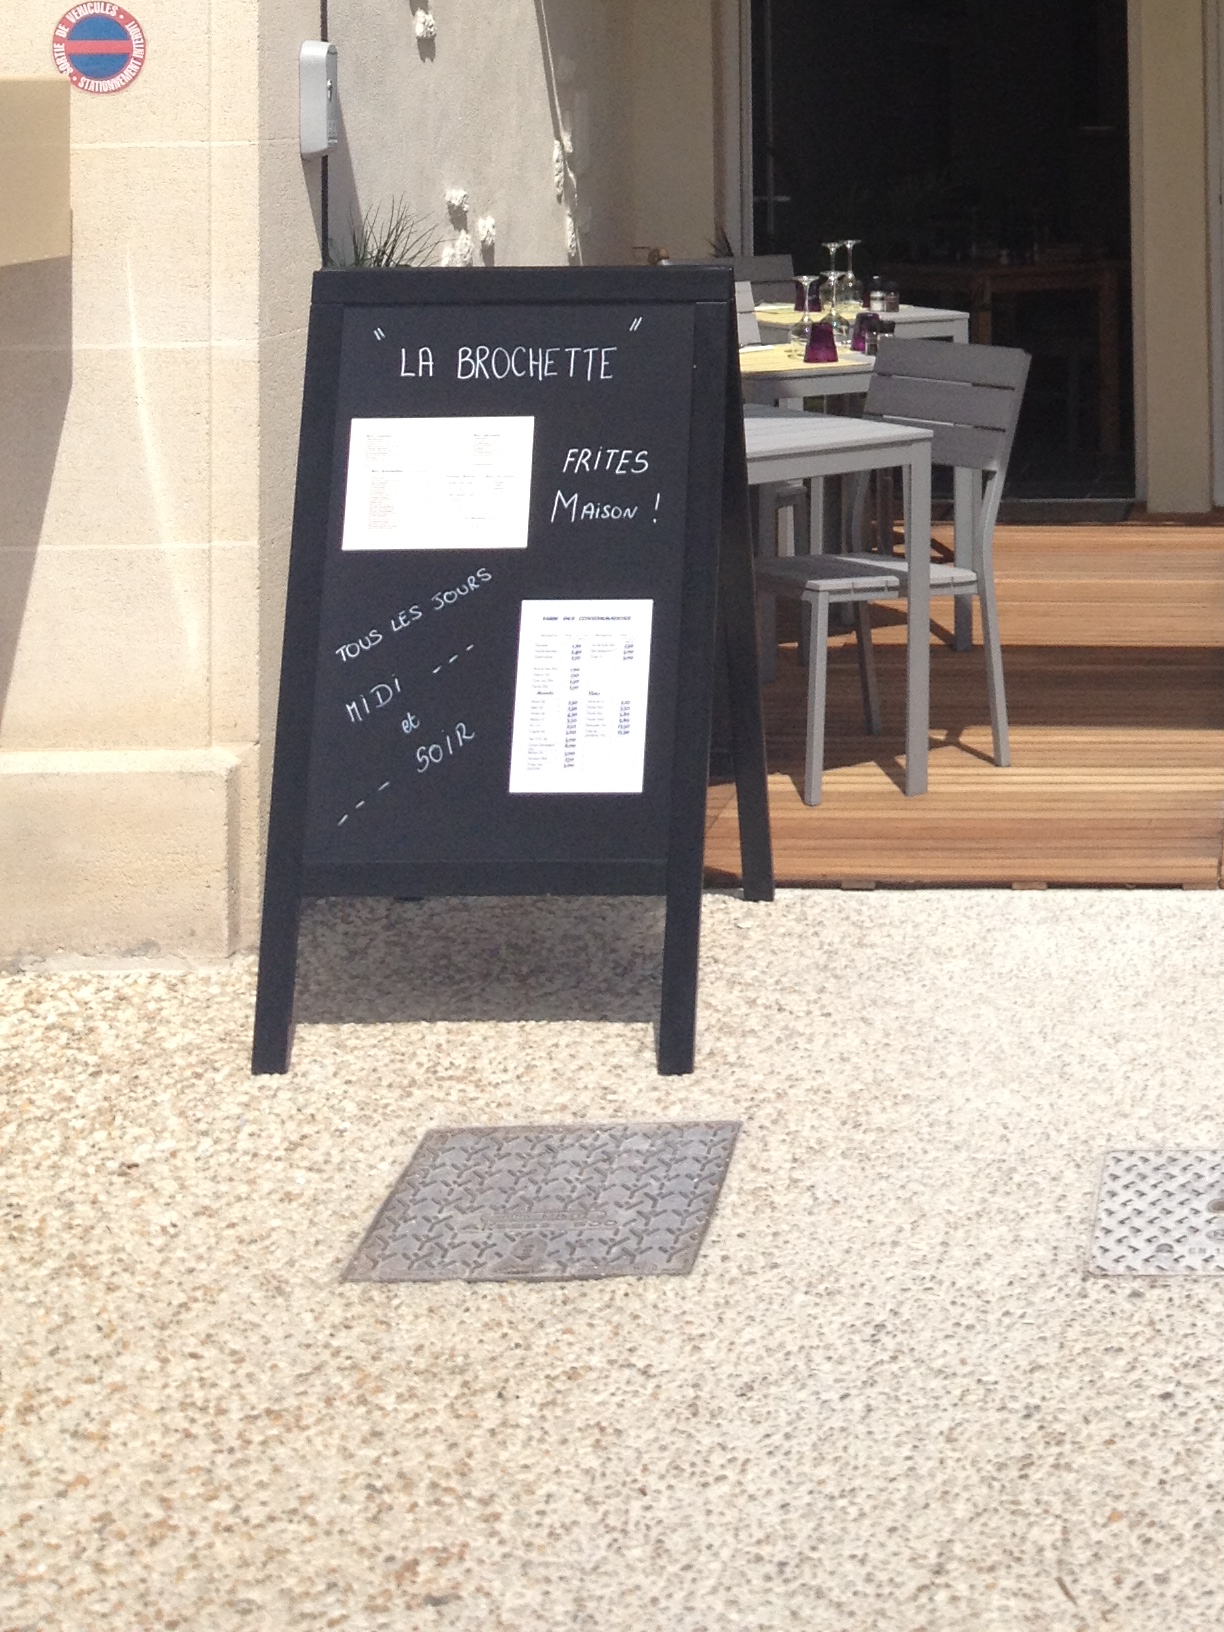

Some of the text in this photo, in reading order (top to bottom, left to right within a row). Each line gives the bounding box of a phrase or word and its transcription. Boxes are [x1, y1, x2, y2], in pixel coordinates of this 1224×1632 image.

[55, 24, 70, 38] DE
[53, 42, 73, 75] SORTIE
[78, 20, 145, 93] STATIONNEMENT INTERDIT
[400, 345, 618, 381] LA BROCHETTE
[335, 567, 493, 662] TOUS LES JOURS
[401, 711, 420, 734] et
[416, 722, 476, 774] SOIR
